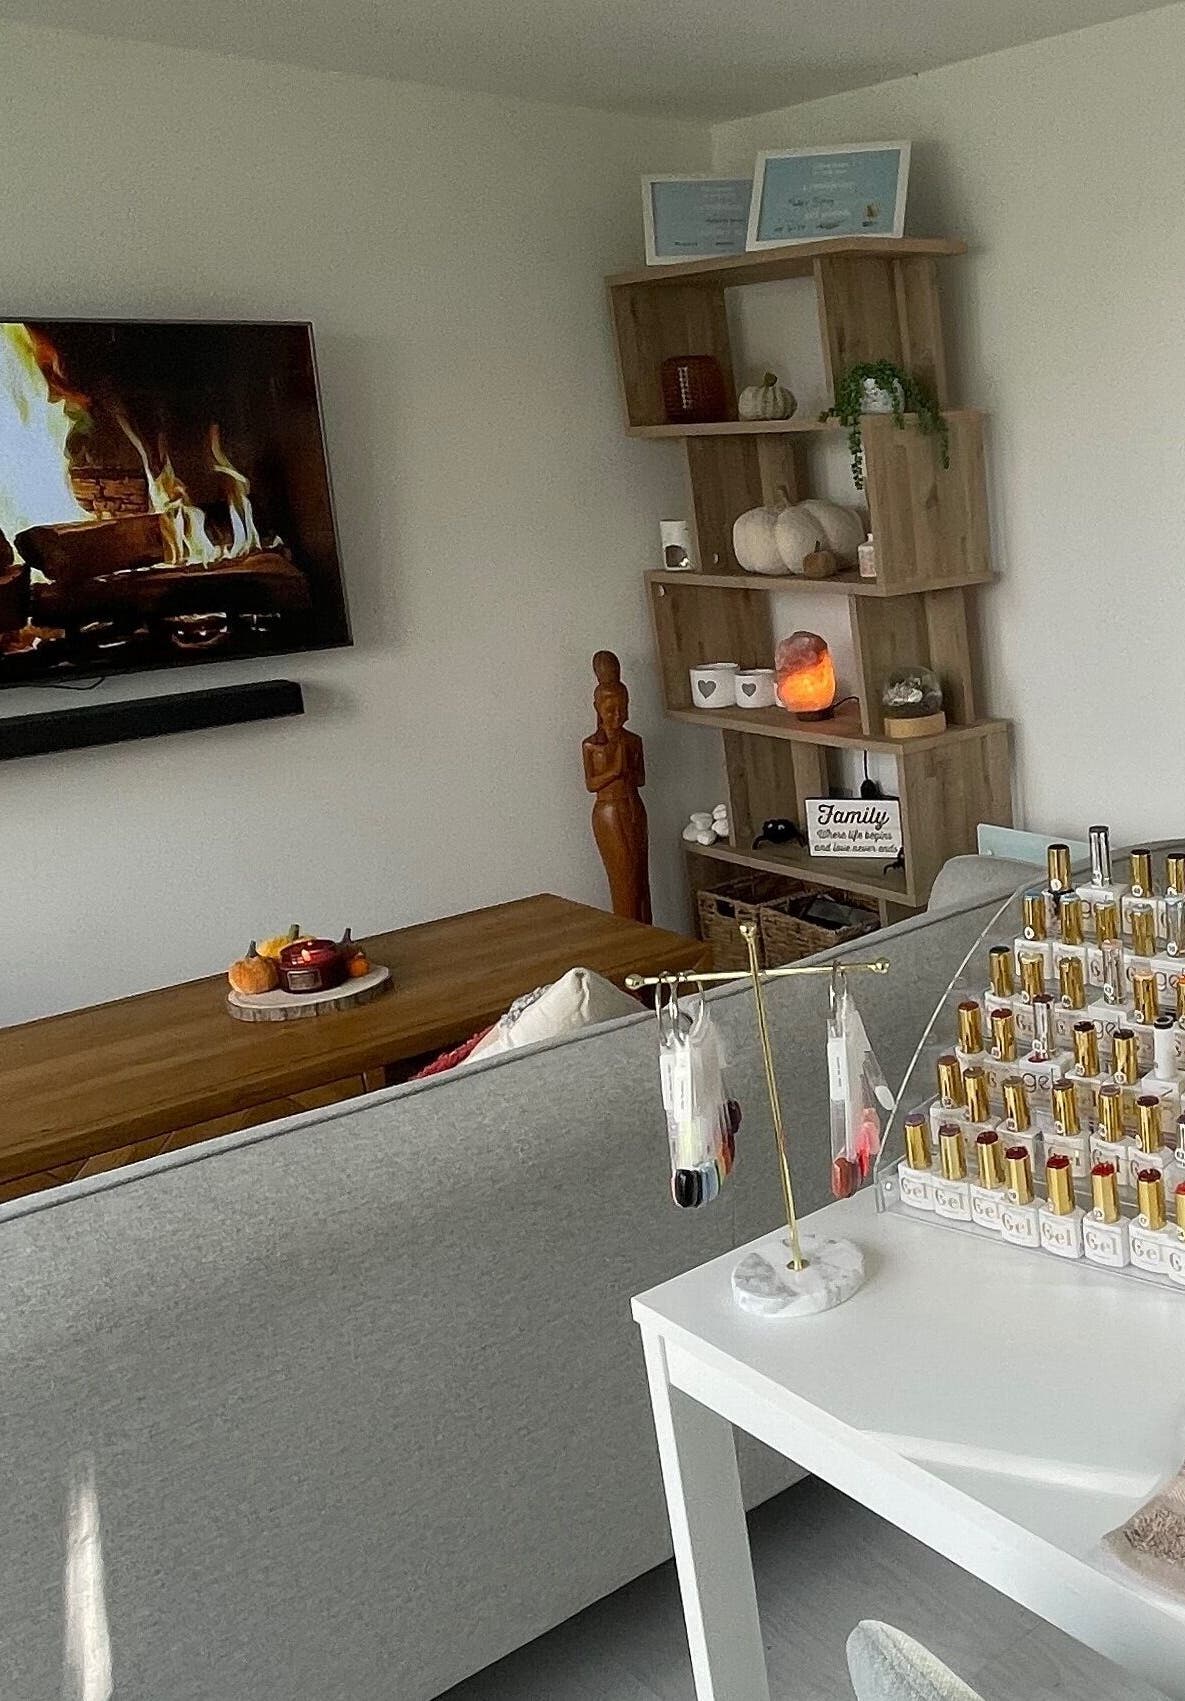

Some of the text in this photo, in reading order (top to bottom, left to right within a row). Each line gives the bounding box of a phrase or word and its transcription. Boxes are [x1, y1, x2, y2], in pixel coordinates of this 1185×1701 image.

[818, 804, 890, 830] Family
[817, 829, 893, 842] Where life begins
[814, 844, 831, 852] and
[833, 844, 851, 852] love
[878, 845, 898, 853] ends
[901, 1176, 928, 1199] Gel
[935, 1188, 964, 1210] Gel
[1002, 1212, 1031, 1236] Gel
[1042, 1222, 1073, 1246] Gel
[1085, 1232, 1118, 1256] Gel
[1131, 1238, 1165, 1262] Gel
